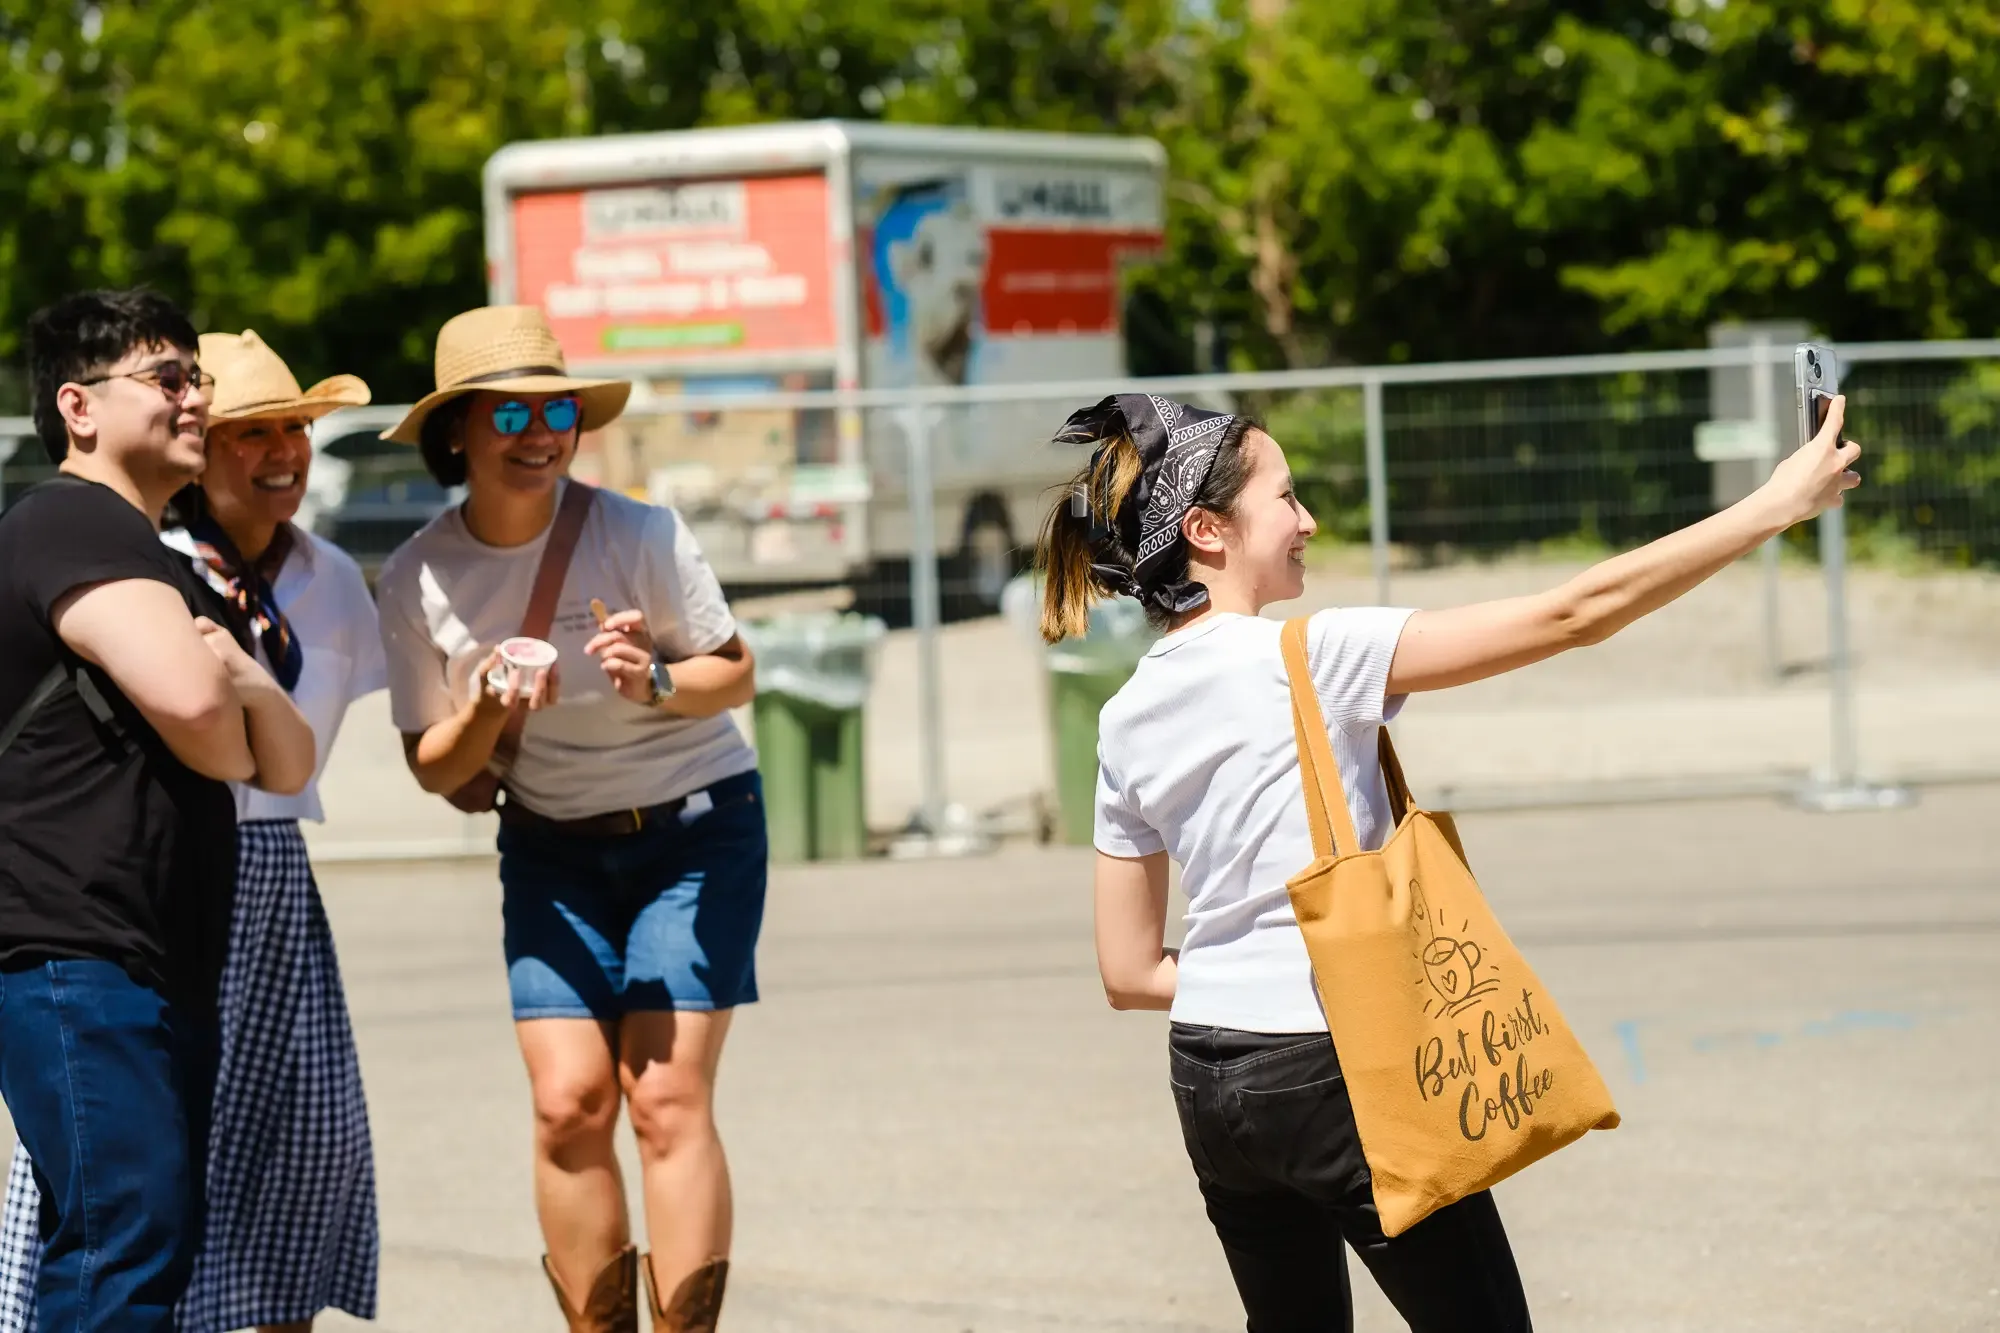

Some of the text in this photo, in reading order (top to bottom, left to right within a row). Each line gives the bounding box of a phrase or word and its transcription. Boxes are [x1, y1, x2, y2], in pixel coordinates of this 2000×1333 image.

[1415, 988, 1549, 1102] But first,
[1459, 1053, 1553, 1141] Coffee
